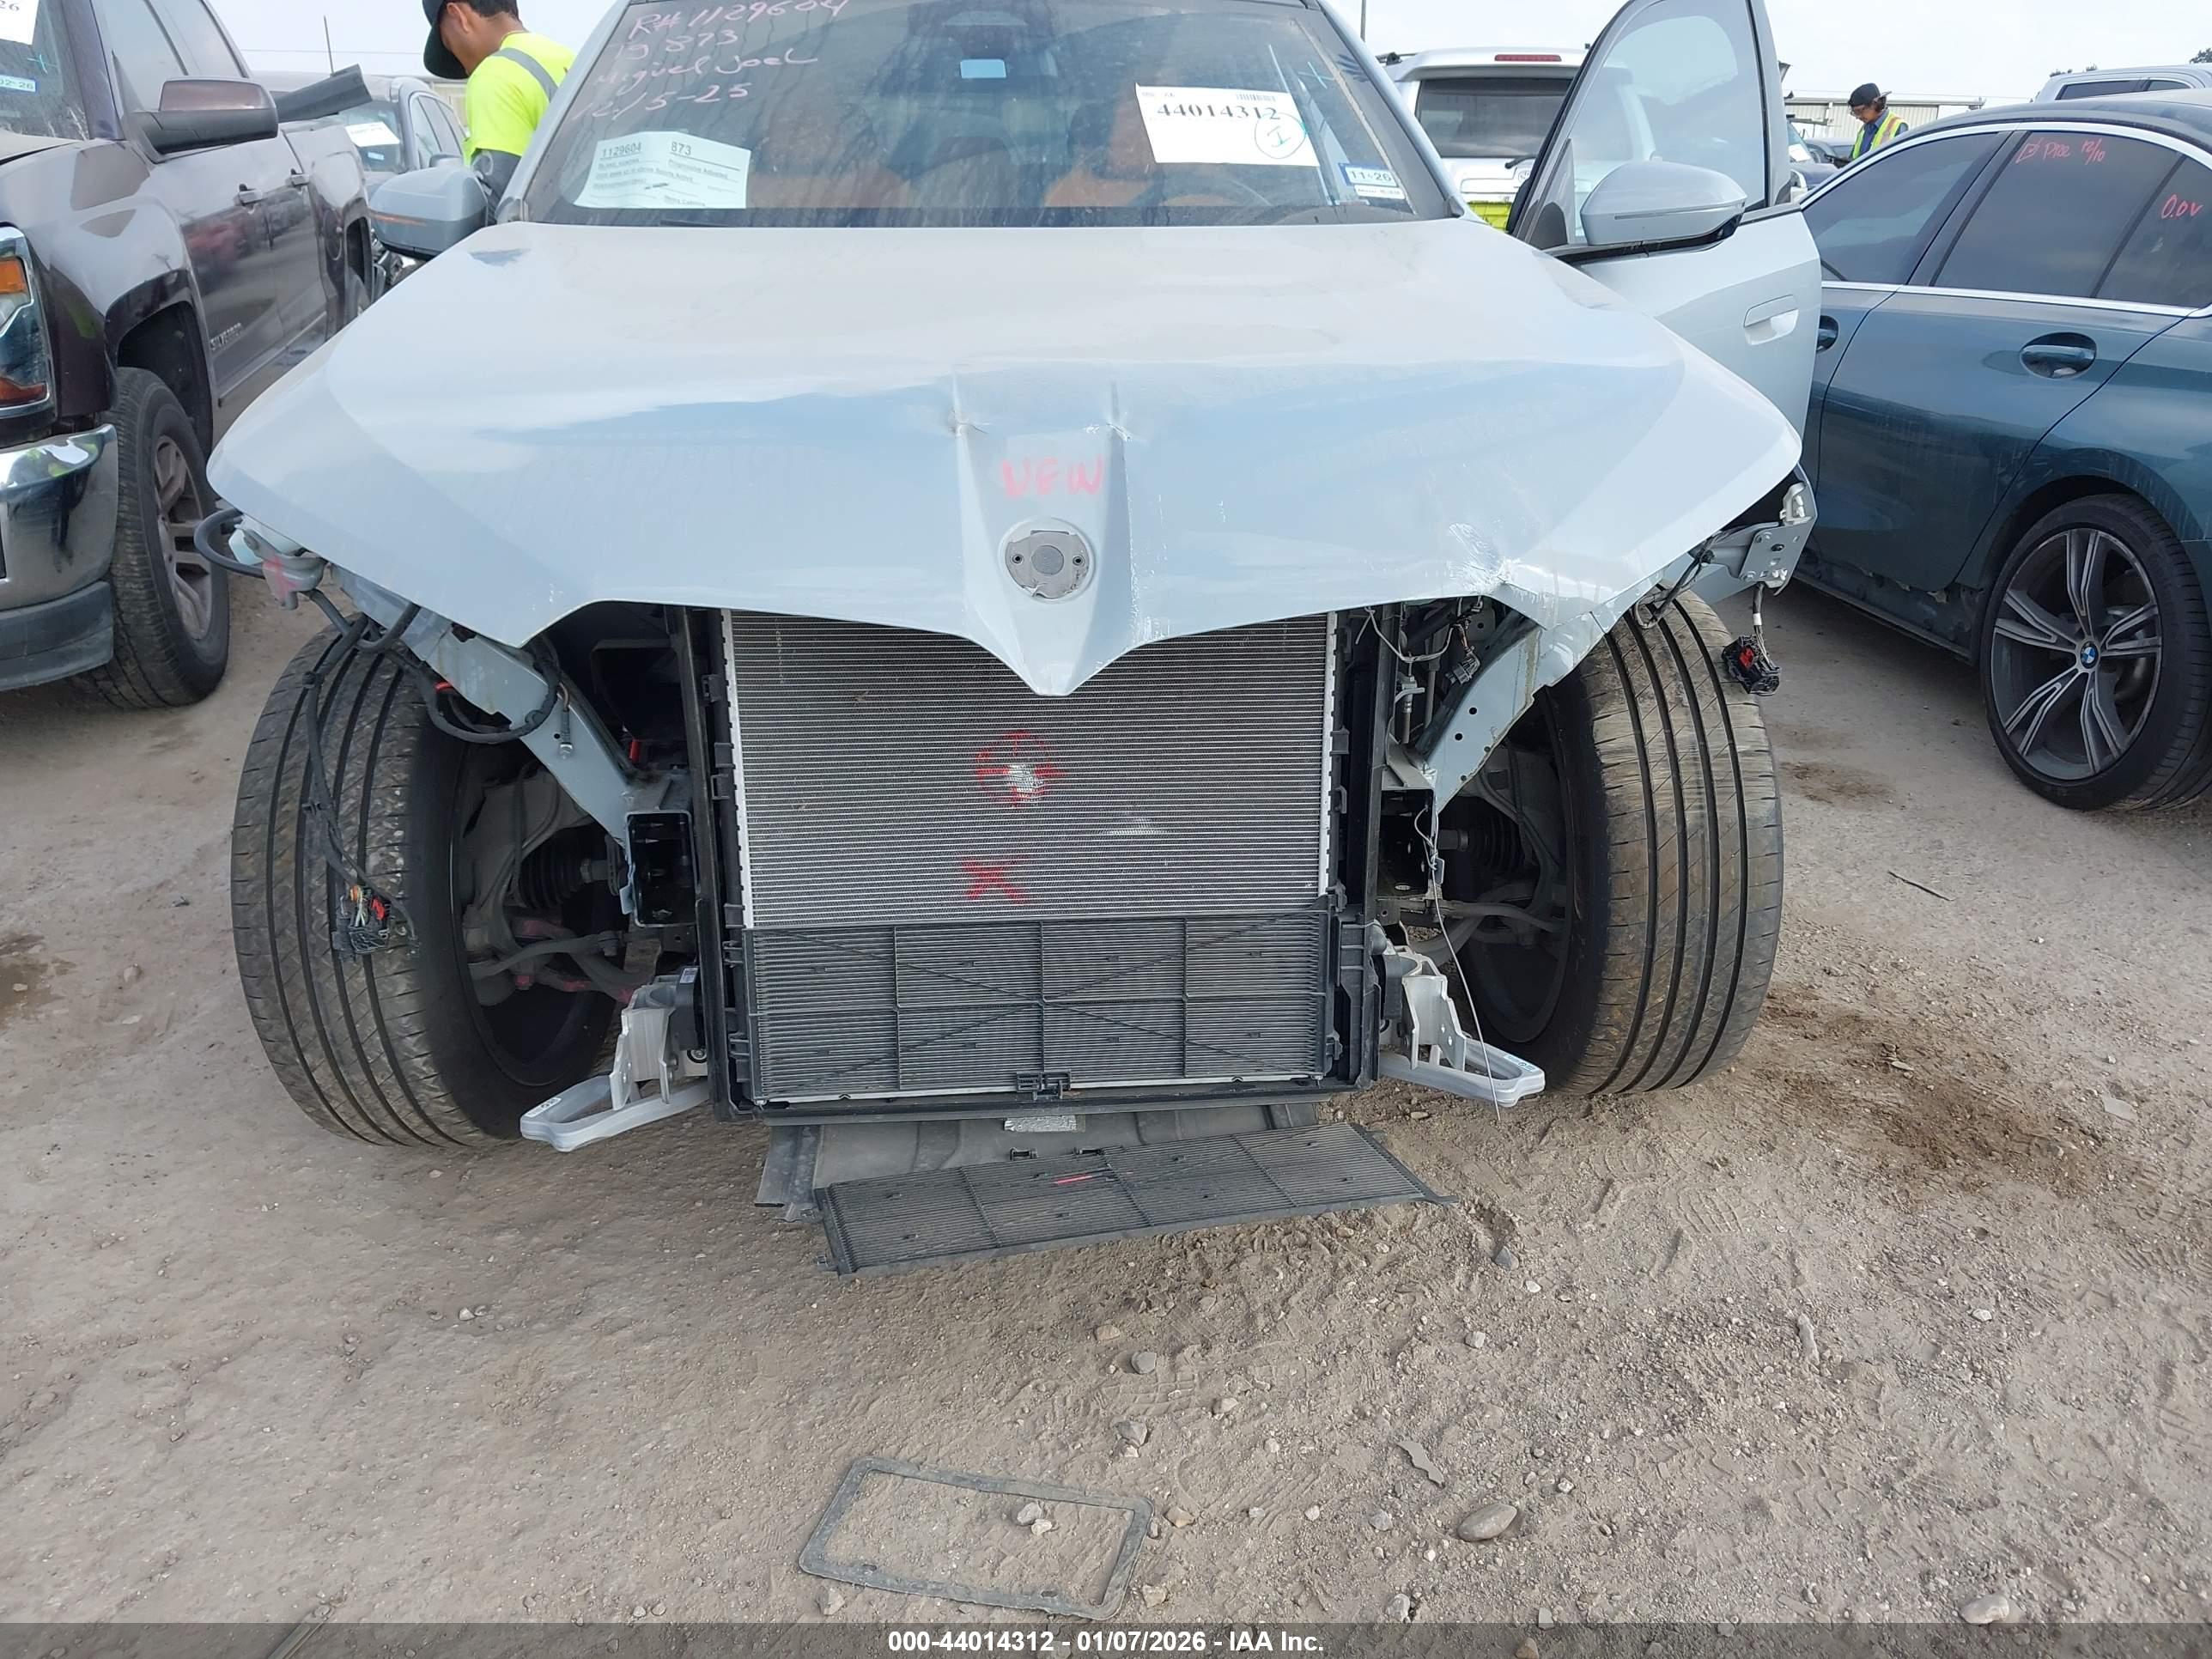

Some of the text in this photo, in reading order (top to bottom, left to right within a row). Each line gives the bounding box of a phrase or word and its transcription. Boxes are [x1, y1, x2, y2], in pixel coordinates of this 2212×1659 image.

[665, 29, 738, 52] 873
[1157, 103, 1281, 120] 44014312
[671, 141, 692, 156] 873
